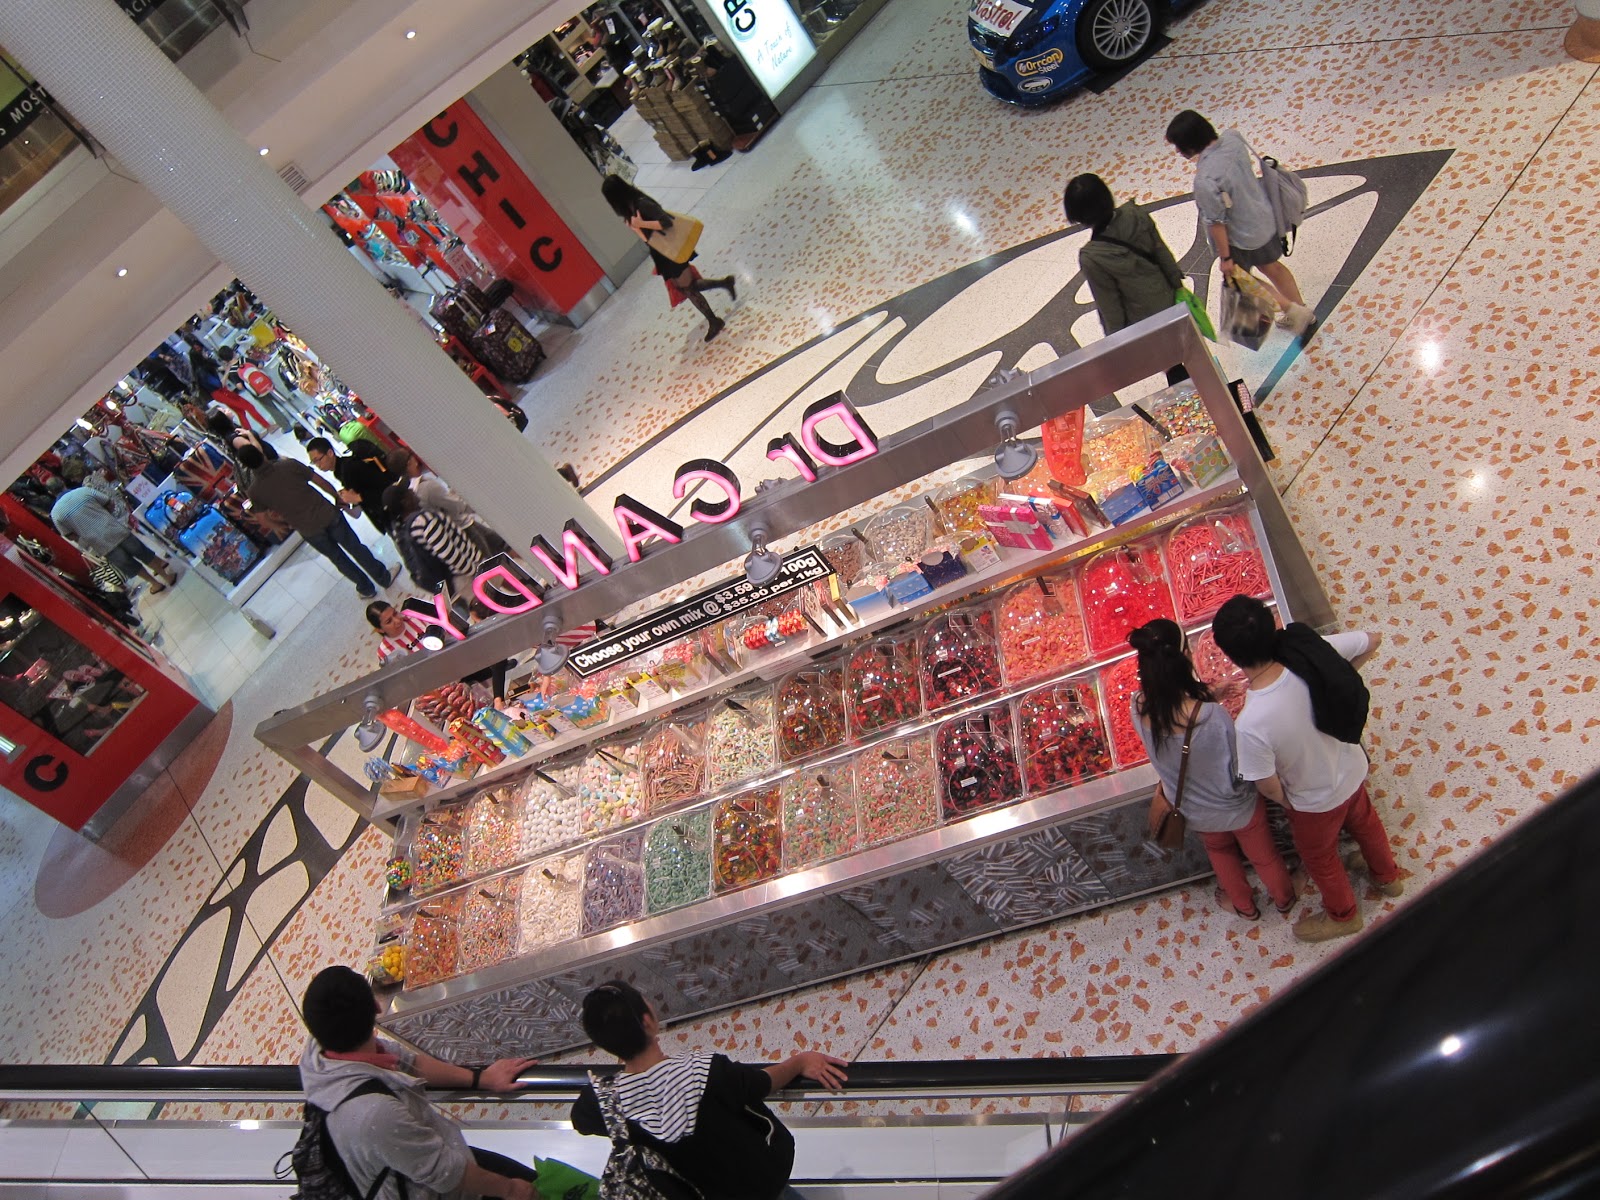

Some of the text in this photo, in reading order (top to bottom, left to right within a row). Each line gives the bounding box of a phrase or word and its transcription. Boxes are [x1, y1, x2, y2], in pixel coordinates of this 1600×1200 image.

[1038, 62, 1060, 74] Steel
[10, 85, 47, 124] MOST
[423, 111, 563, 272] CHIC
[714, 556, 818, 604] $3.59 100g
[723, 587, 769, 611] $35.90
[770, 577, 795, 592] per
[796, 566, 823, 580] 1kg
[574, 600, 722, 668] Choose your own mix @
